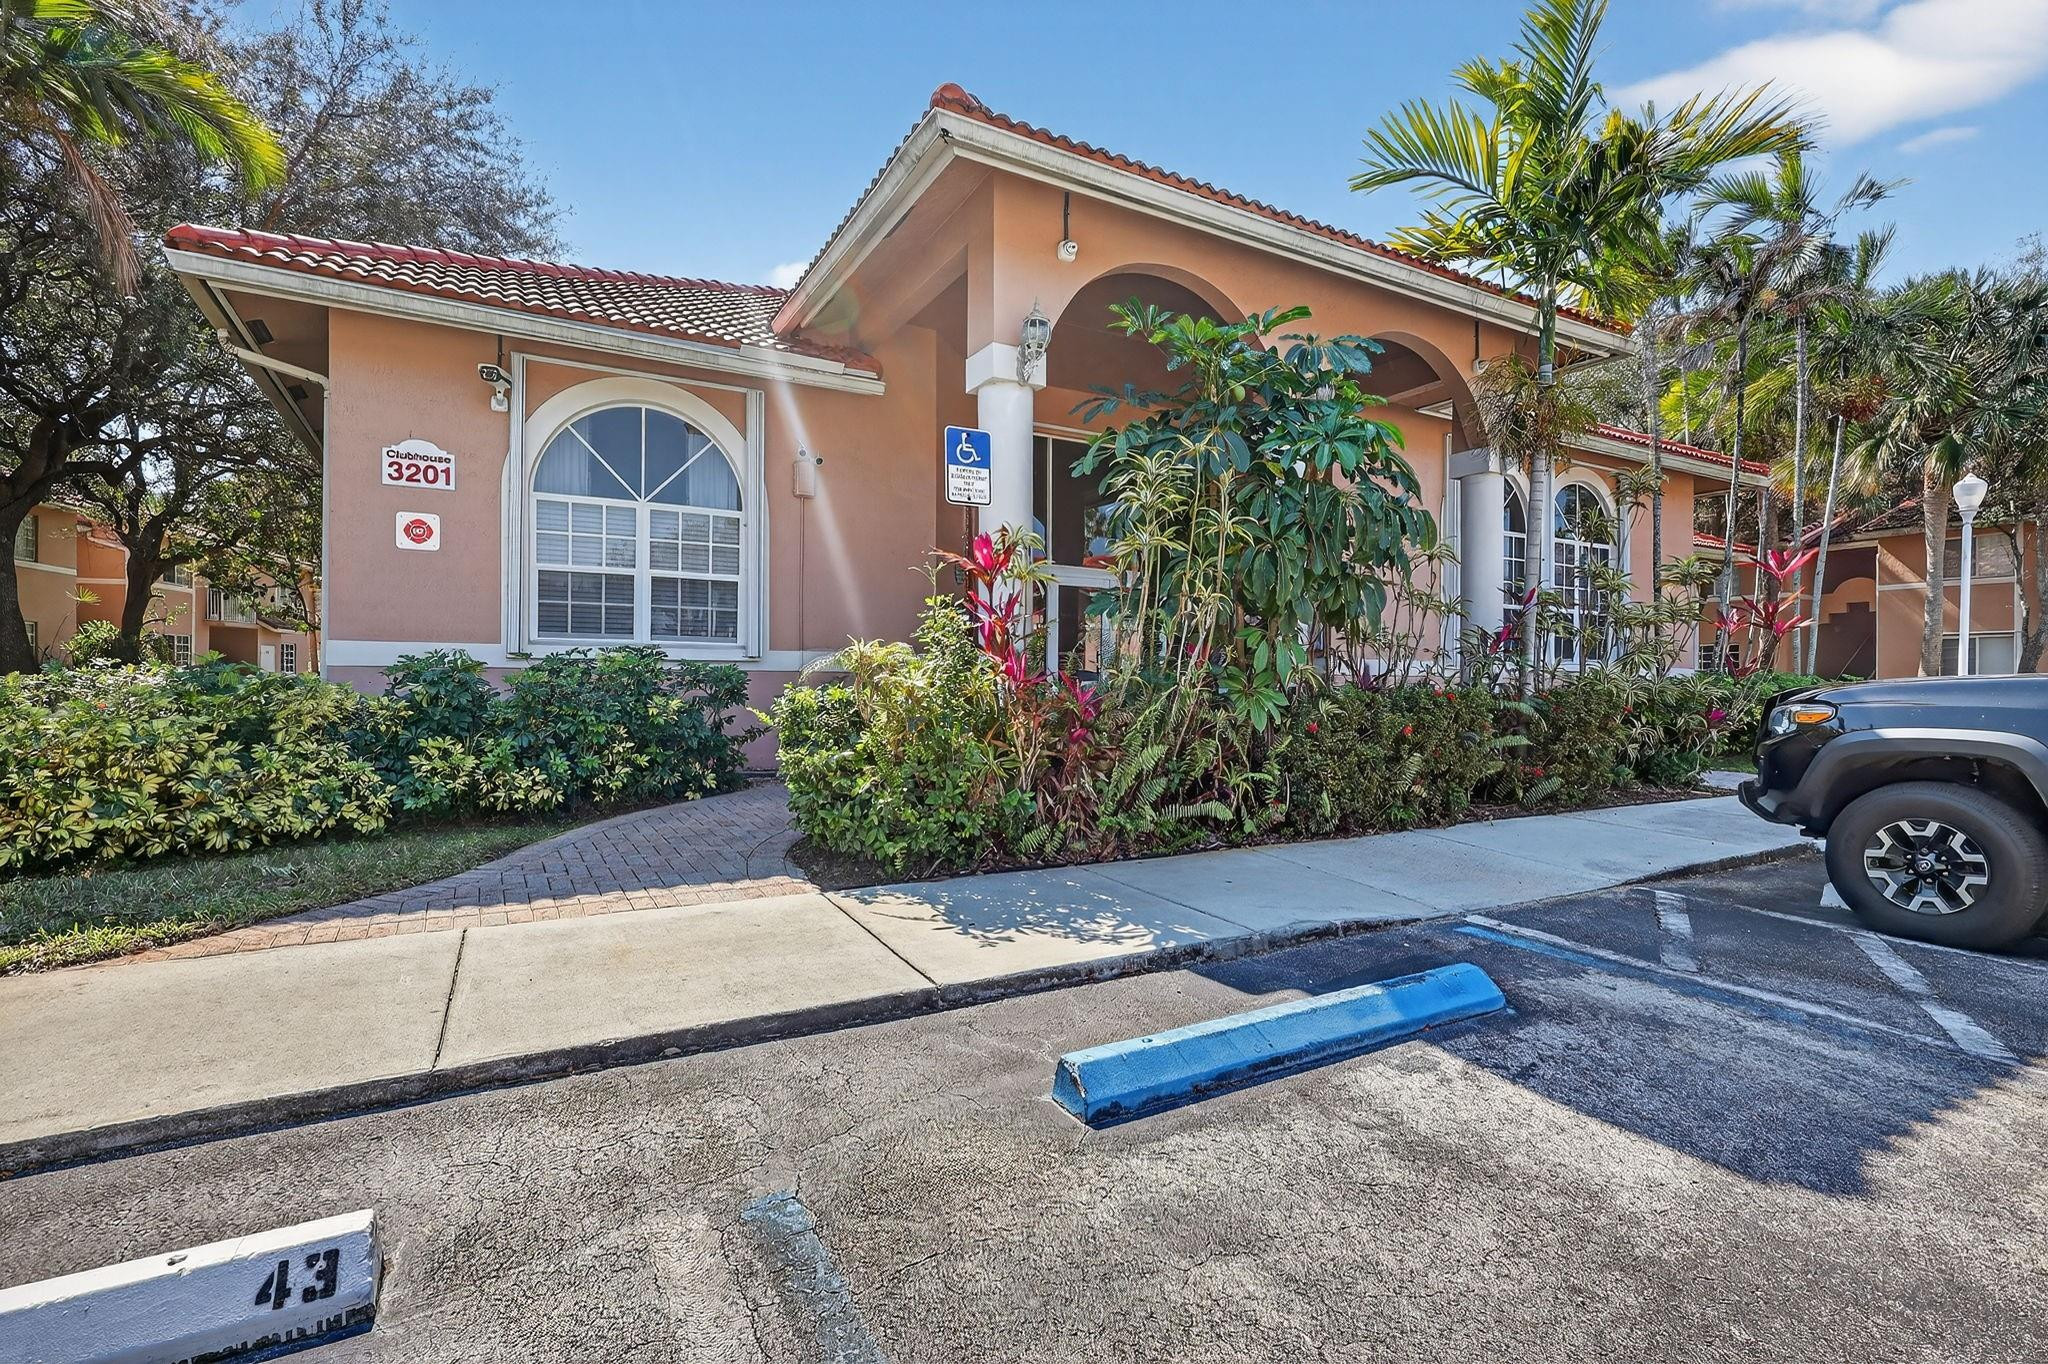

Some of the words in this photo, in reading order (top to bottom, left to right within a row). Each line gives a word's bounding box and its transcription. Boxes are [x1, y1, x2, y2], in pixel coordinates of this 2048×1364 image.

[386, 449, 451, 464] Clubhouse
[387, 461, 451, 486] 3201
[255, 1248, 340, 1311] 43
